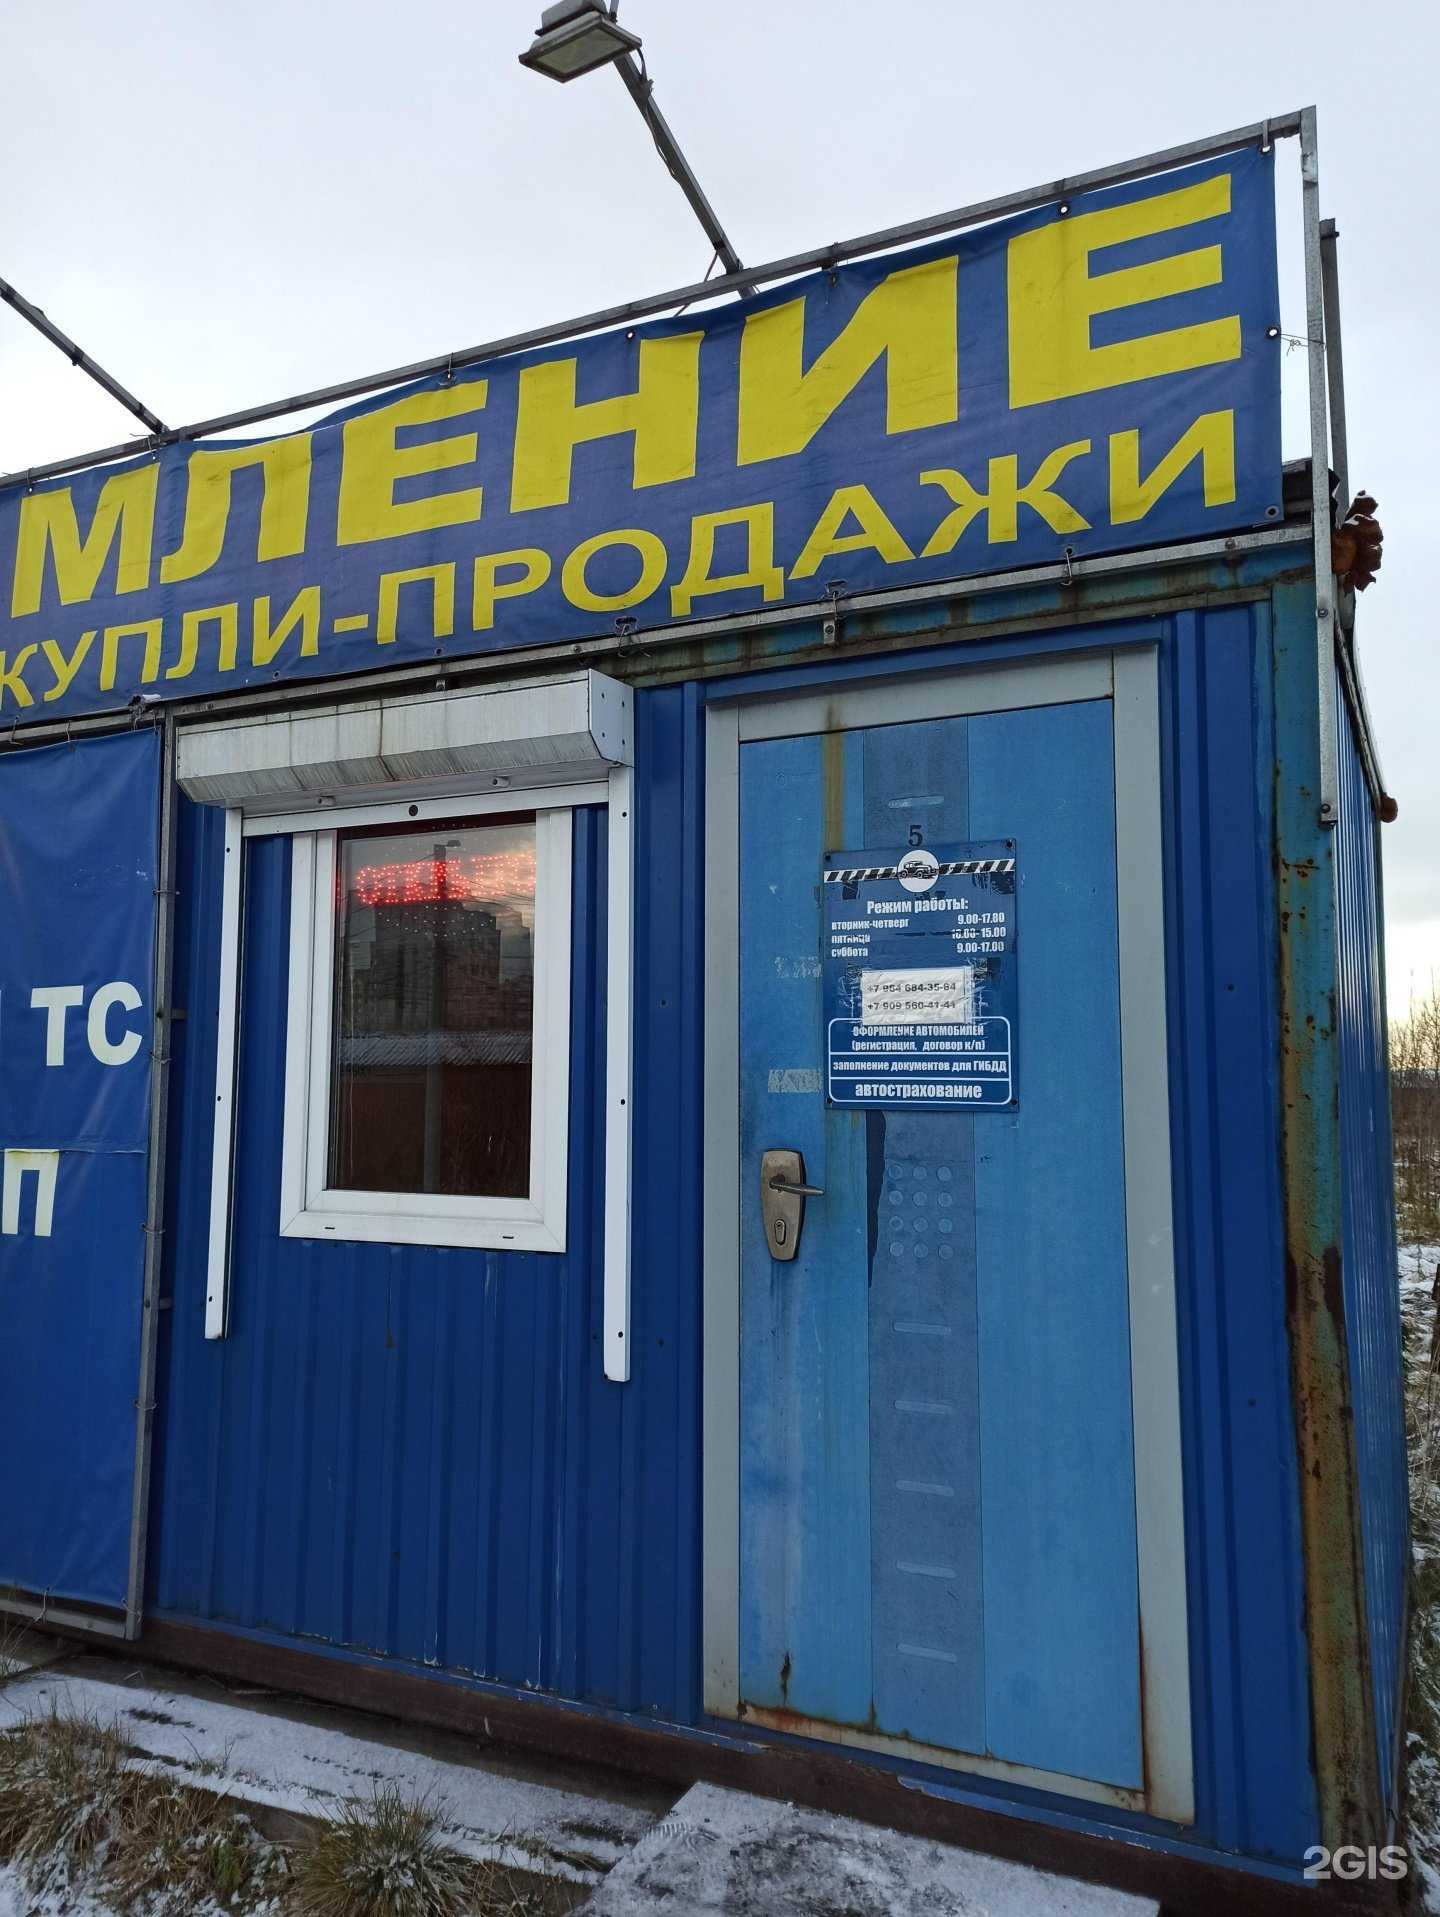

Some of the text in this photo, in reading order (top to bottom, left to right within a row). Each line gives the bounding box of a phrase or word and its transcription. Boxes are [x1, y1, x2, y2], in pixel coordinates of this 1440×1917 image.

[12, 174, 1242, 618] МЛЕНИЕ
[0, 409, 1236, 711] КУПЛИ-ПРОДАЖИ
[908, 824, 923, 846] 5
[867, 897, 969, 914] Режим работы:
[831, 912, 1005, 931] вторник-четверг 9.00-17.00
[831, 941, 1005, 958] суббота 9.00-17.00
[30, 981, 143, 1067] ТС
[853, 1025, 914, 1037] ОФОРМЛЕНИЕ
[923, 1041, 963, 1051] договор
[833, 1060, 1007, 1073] заполнение документов для ГИБДД
[855, 1084, 983, 1099] автострахование
